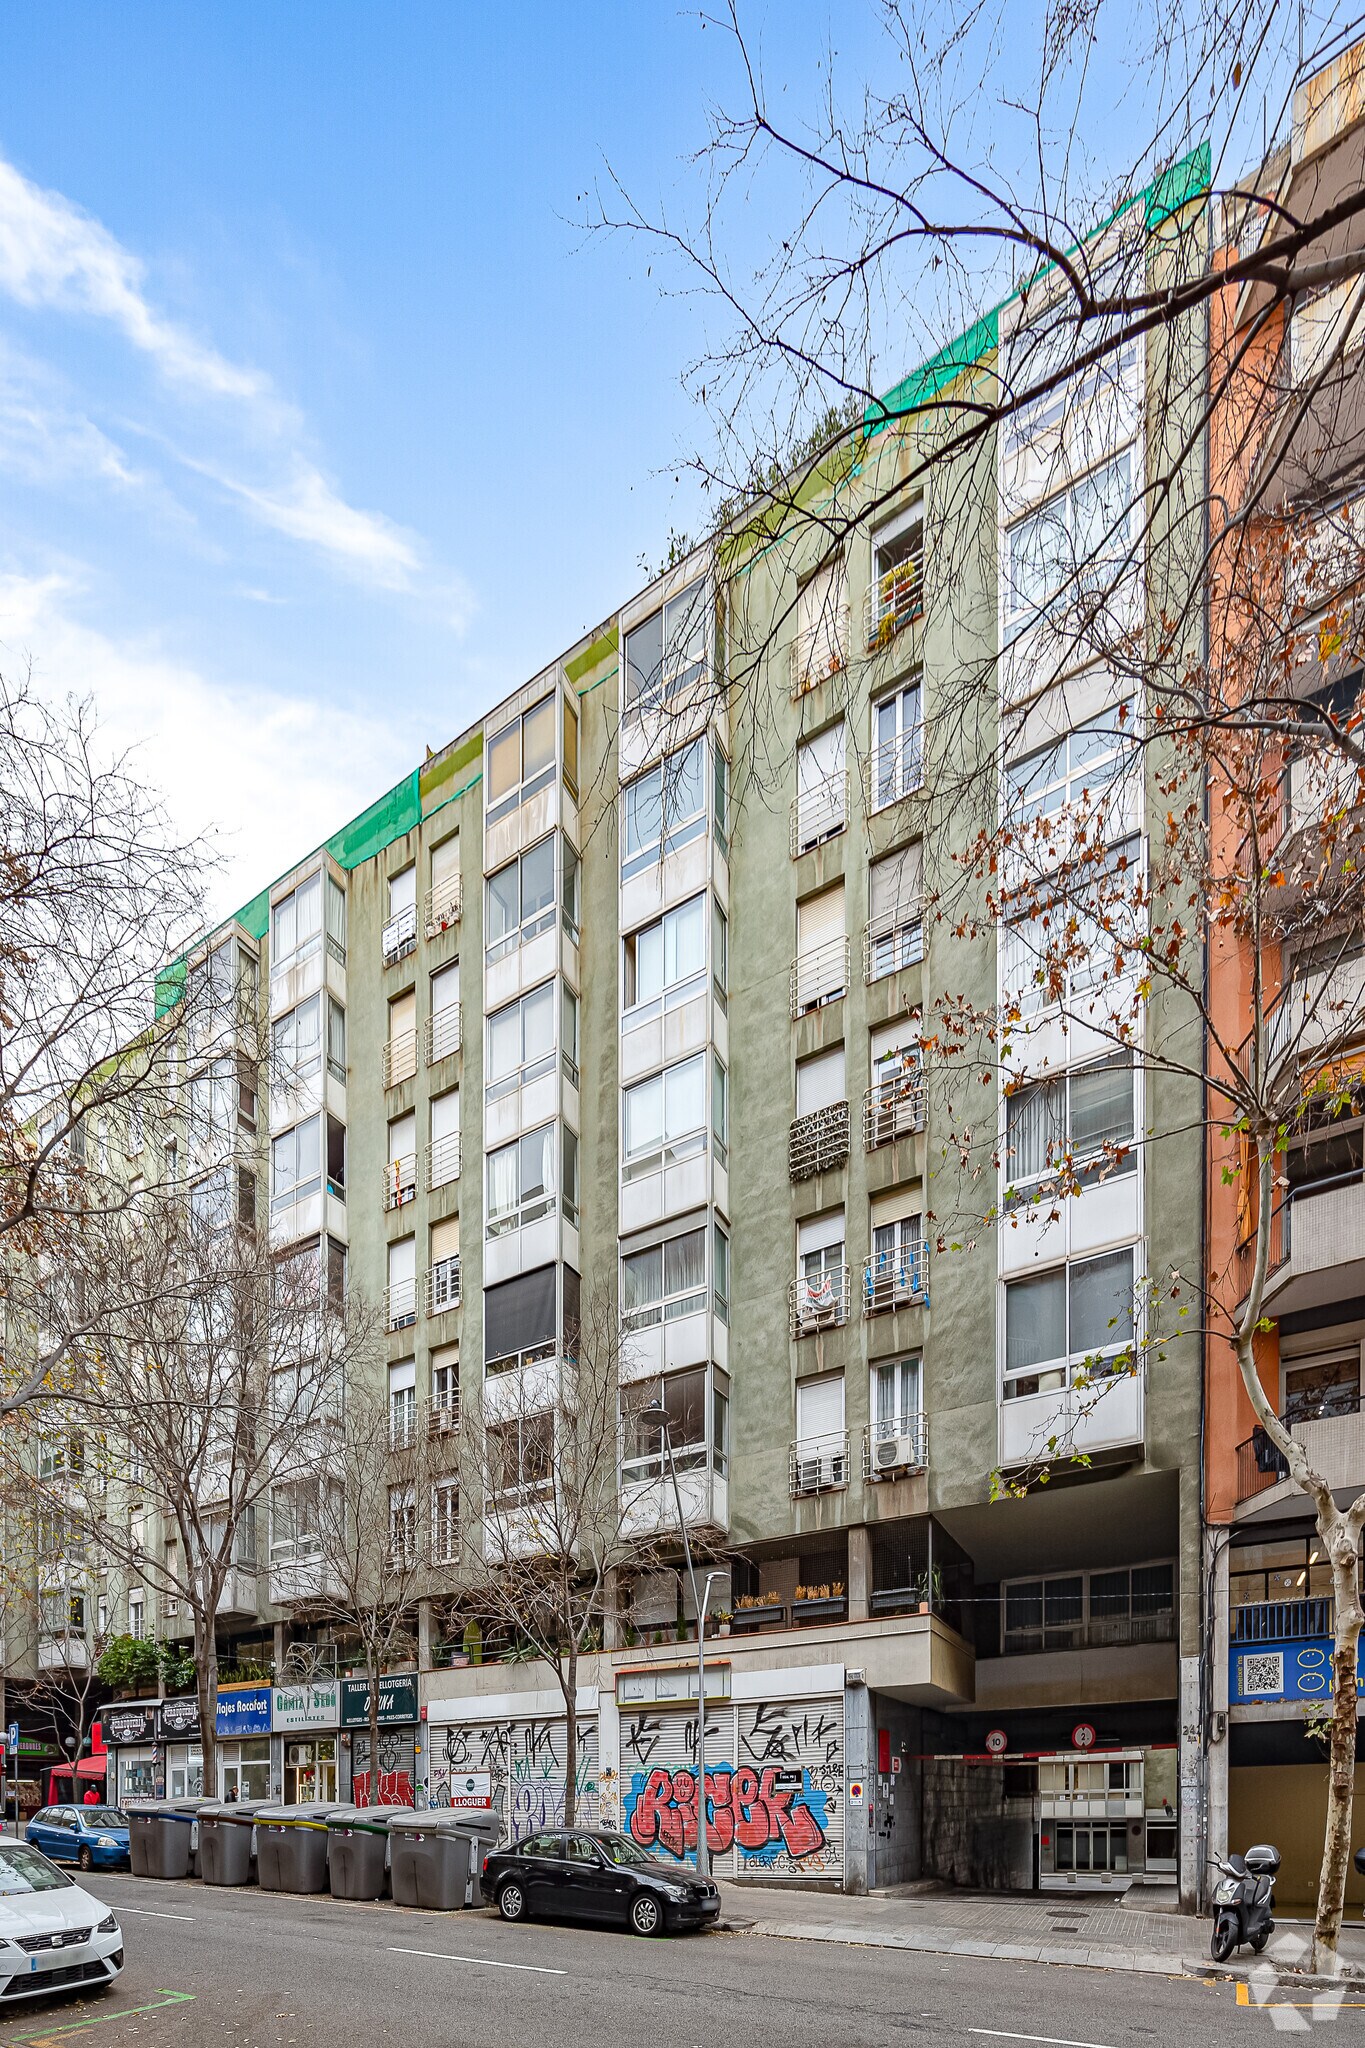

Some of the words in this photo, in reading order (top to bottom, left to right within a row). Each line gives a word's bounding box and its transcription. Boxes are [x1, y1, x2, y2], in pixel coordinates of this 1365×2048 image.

[348, 1683, 367, 1693] TALLER
[378, 1678, 412, 1690] ELLOTGERIA
[236, 1699, 268, 1713] Rocafort
[10, 1727, 16, 1746] P
[992, 1737, 1001, 1747] 10
[454, 1797, 487, 1807] LLOGUER
